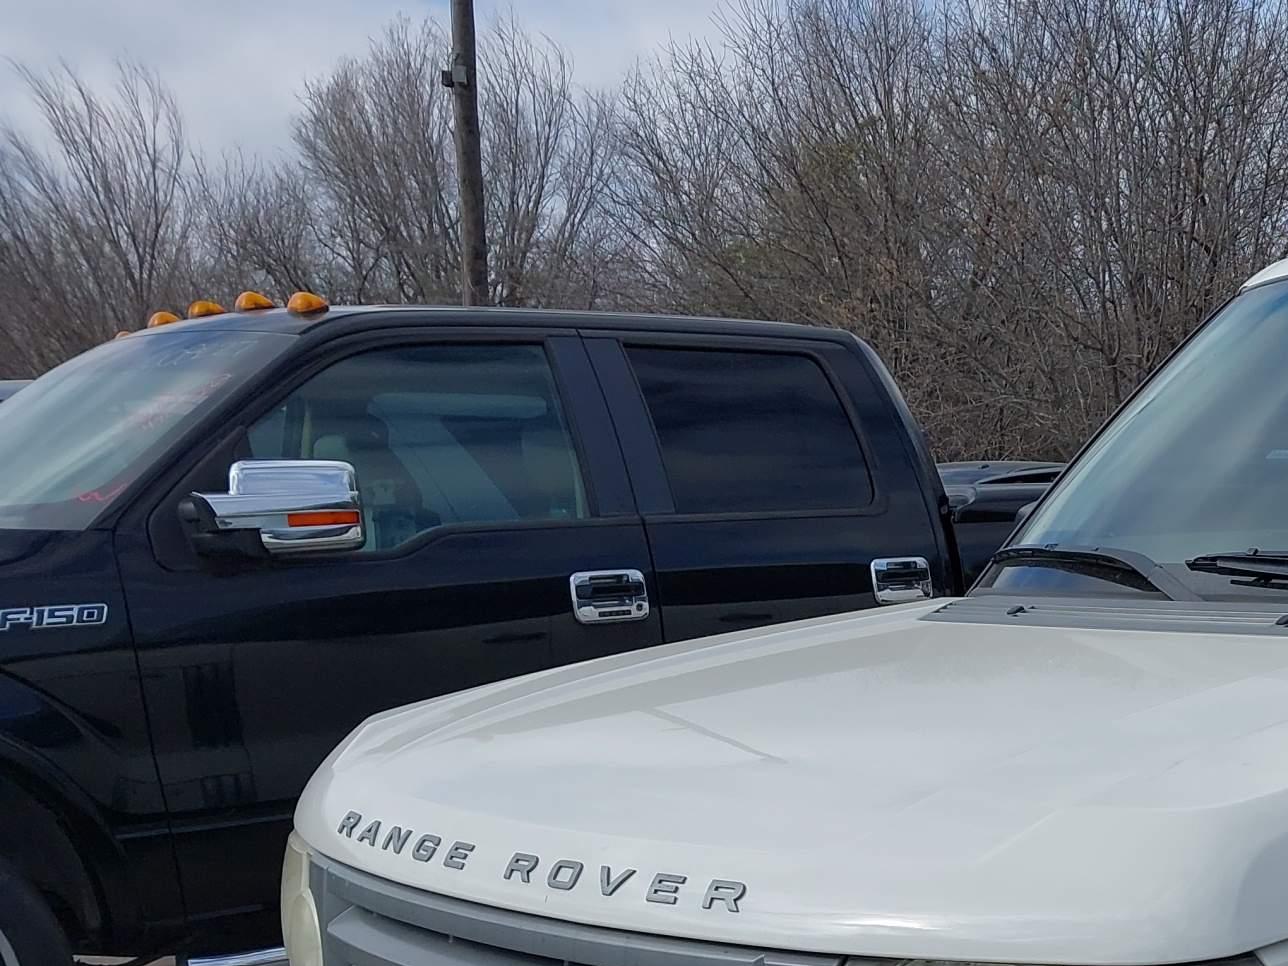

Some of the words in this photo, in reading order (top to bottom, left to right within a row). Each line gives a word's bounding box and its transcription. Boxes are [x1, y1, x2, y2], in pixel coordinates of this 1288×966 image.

[0, 603, 108, 630] F-150
[337, 810, 476, 871] RANGE
[503, 852, 747, 913] ROVER
